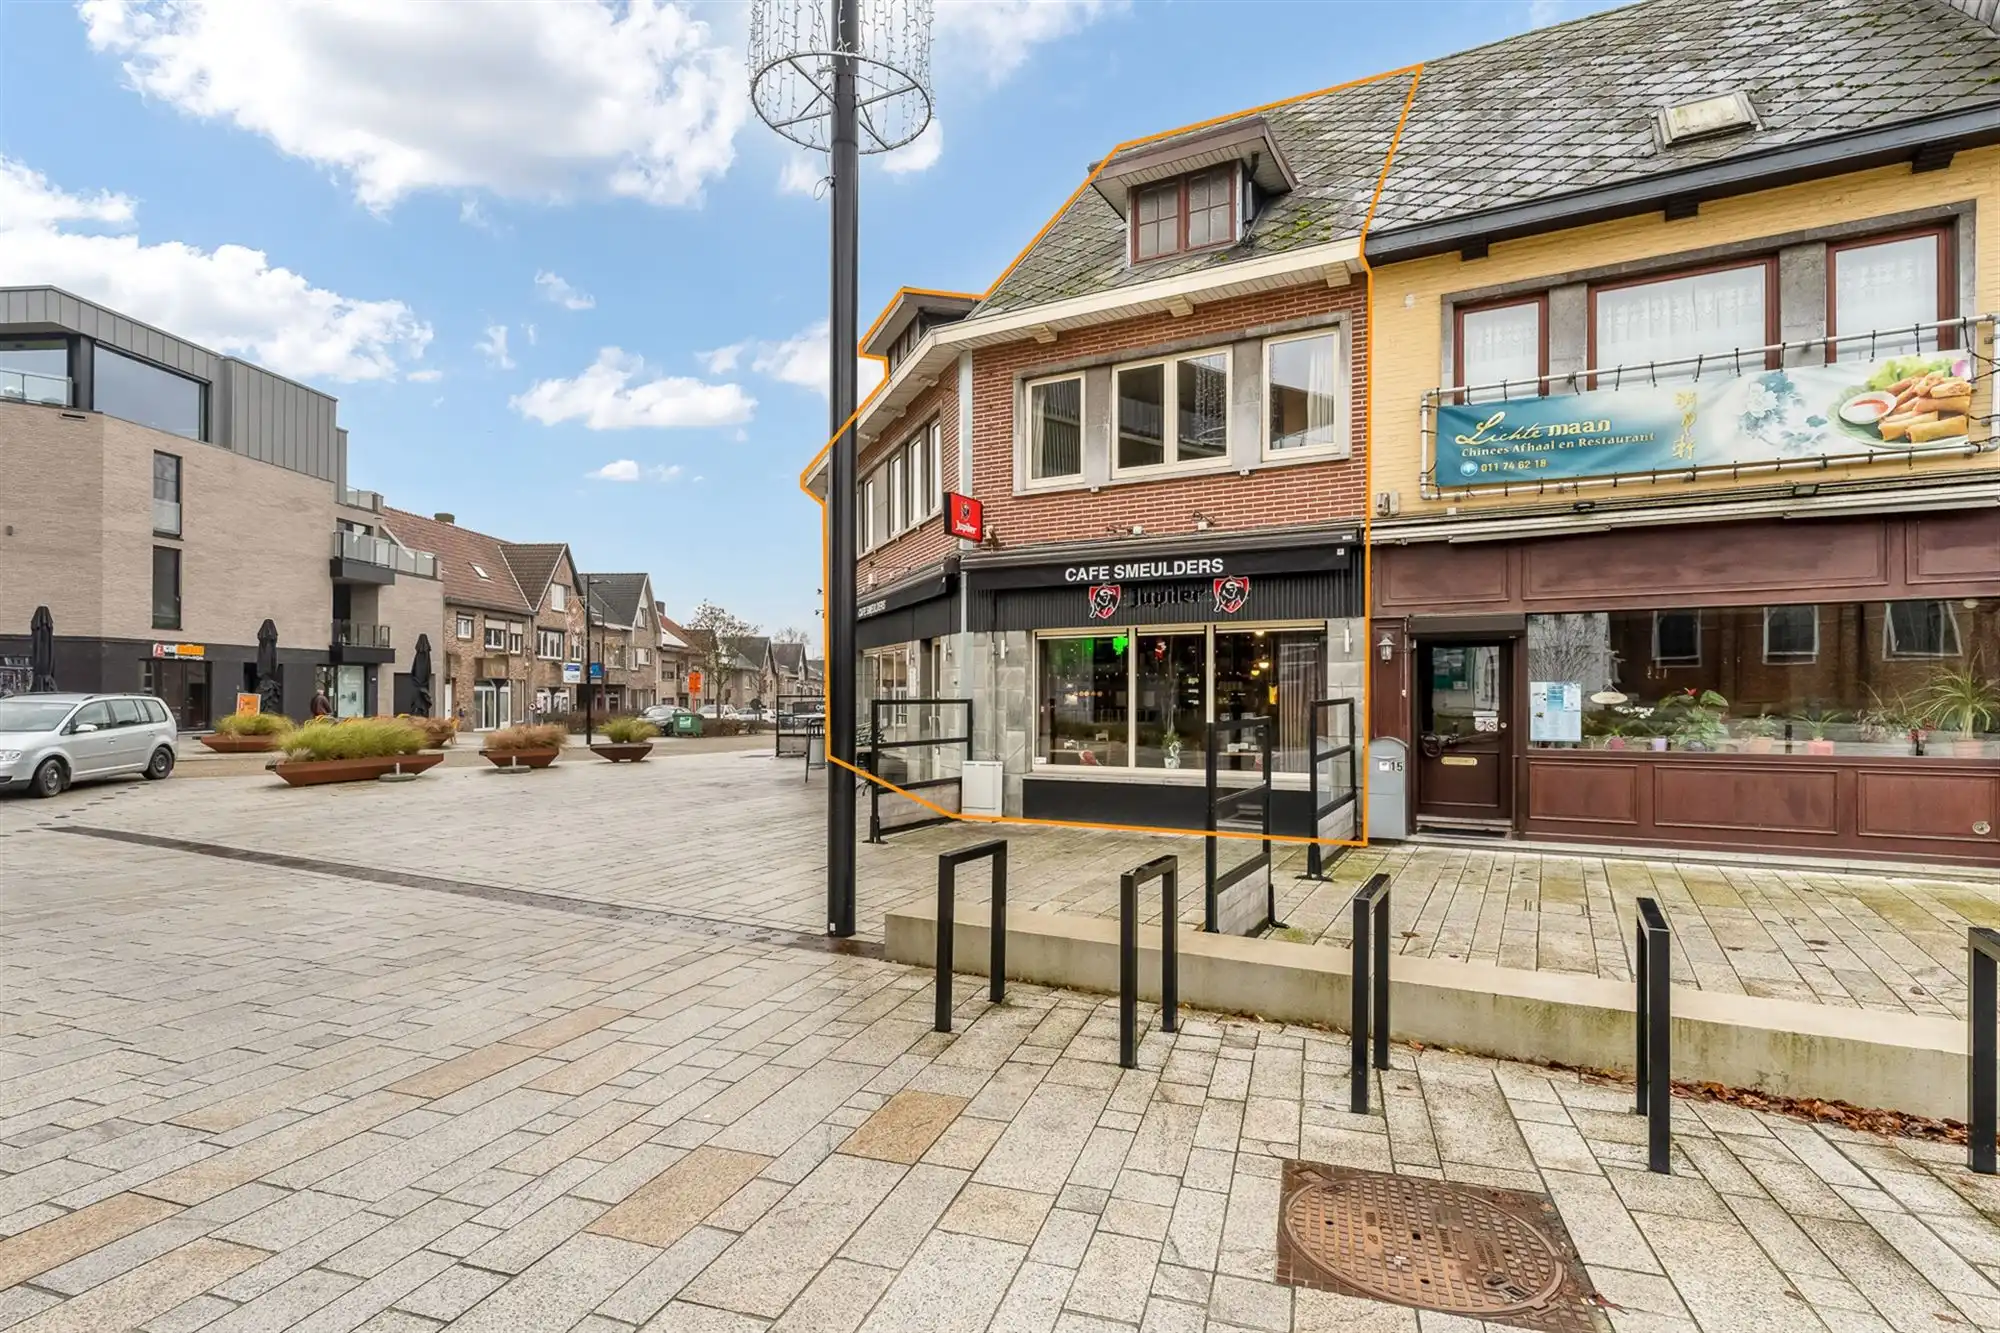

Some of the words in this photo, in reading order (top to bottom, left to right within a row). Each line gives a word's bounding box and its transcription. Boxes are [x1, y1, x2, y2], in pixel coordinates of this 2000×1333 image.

[1455, 411, 1544, 445] Lichte
[1548, 419, 1611, 437] maan
[1461, 446, 1510, 457] Chinees
[1512, 439, 1555, 453] Afhaal
[1558, 440, 1574, 449] en
[1578, 432, 1655, 448] Restaurant
[1481, 462, 1499, 473] 011
[1503, 461, 1515, 471] 74
[1518, 460, 1531, 470] 62
[1534, 459, 1548, 469] 18
[1064, 565, 1110, 582] CAFE
[1113, 557, 1224, 579] SMEULDERS
[1130, 584, 1207, 609] Jupiler
[1390, 761, 1403, 772] 15
